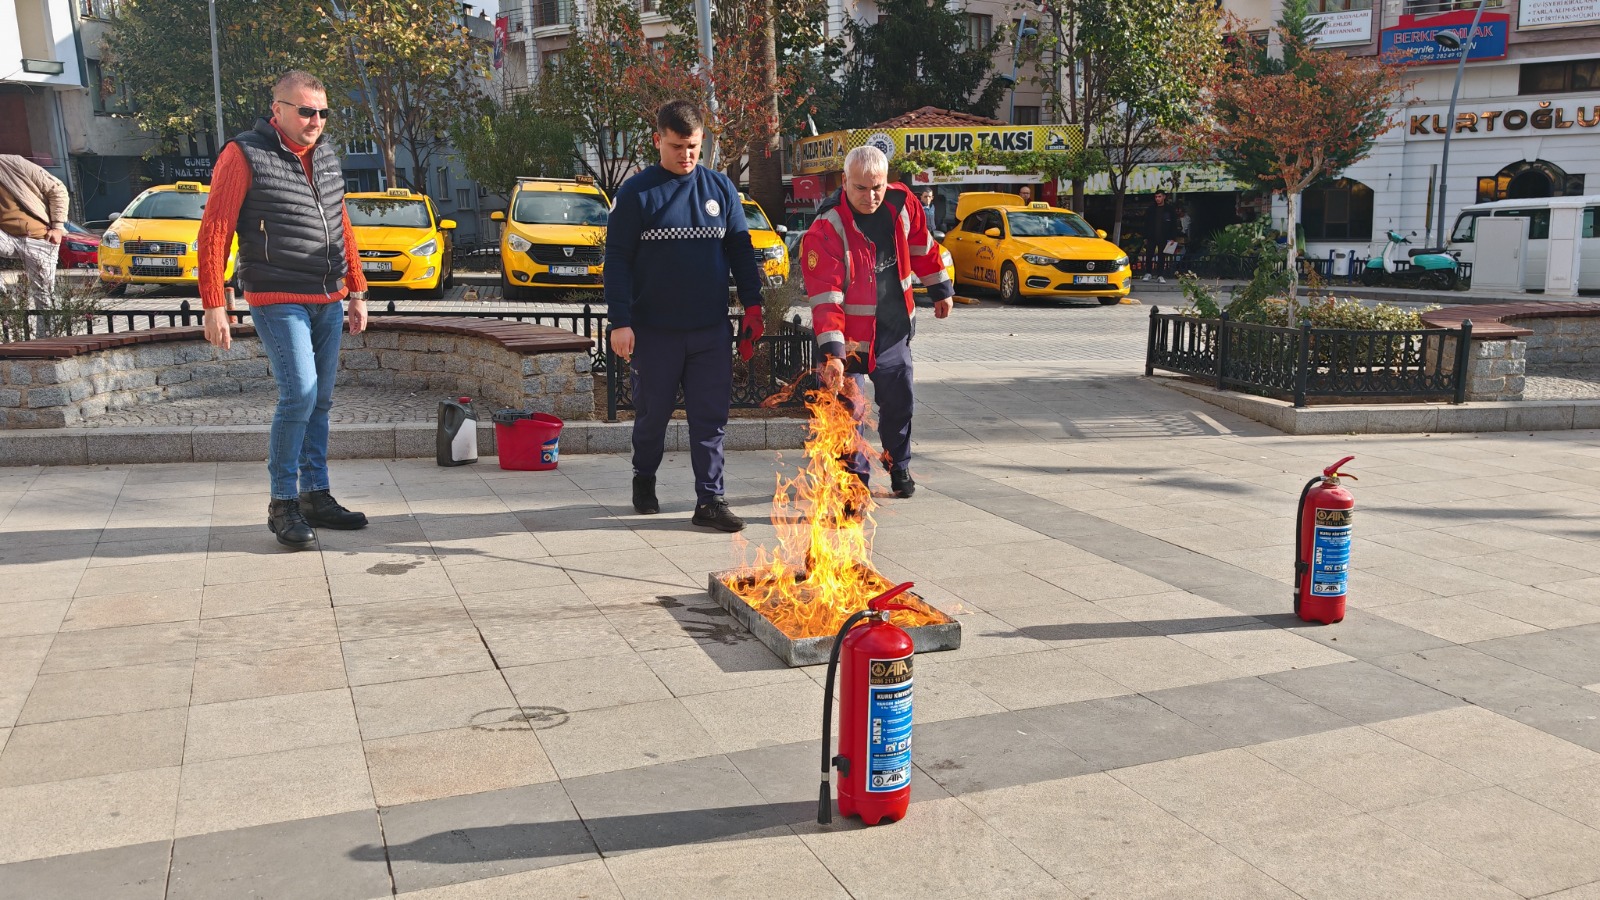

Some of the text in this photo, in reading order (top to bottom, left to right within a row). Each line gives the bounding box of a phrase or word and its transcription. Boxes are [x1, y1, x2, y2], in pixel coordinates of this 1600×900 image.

[1409, 101, 1600, 136] KURTOĞLU
[905, 132, 973, 153] HUZUR
[1326, 511, 1345, 521] ATA
[884, 660, 909, 677] ATA
[886, 772, 904, 784] ATA
